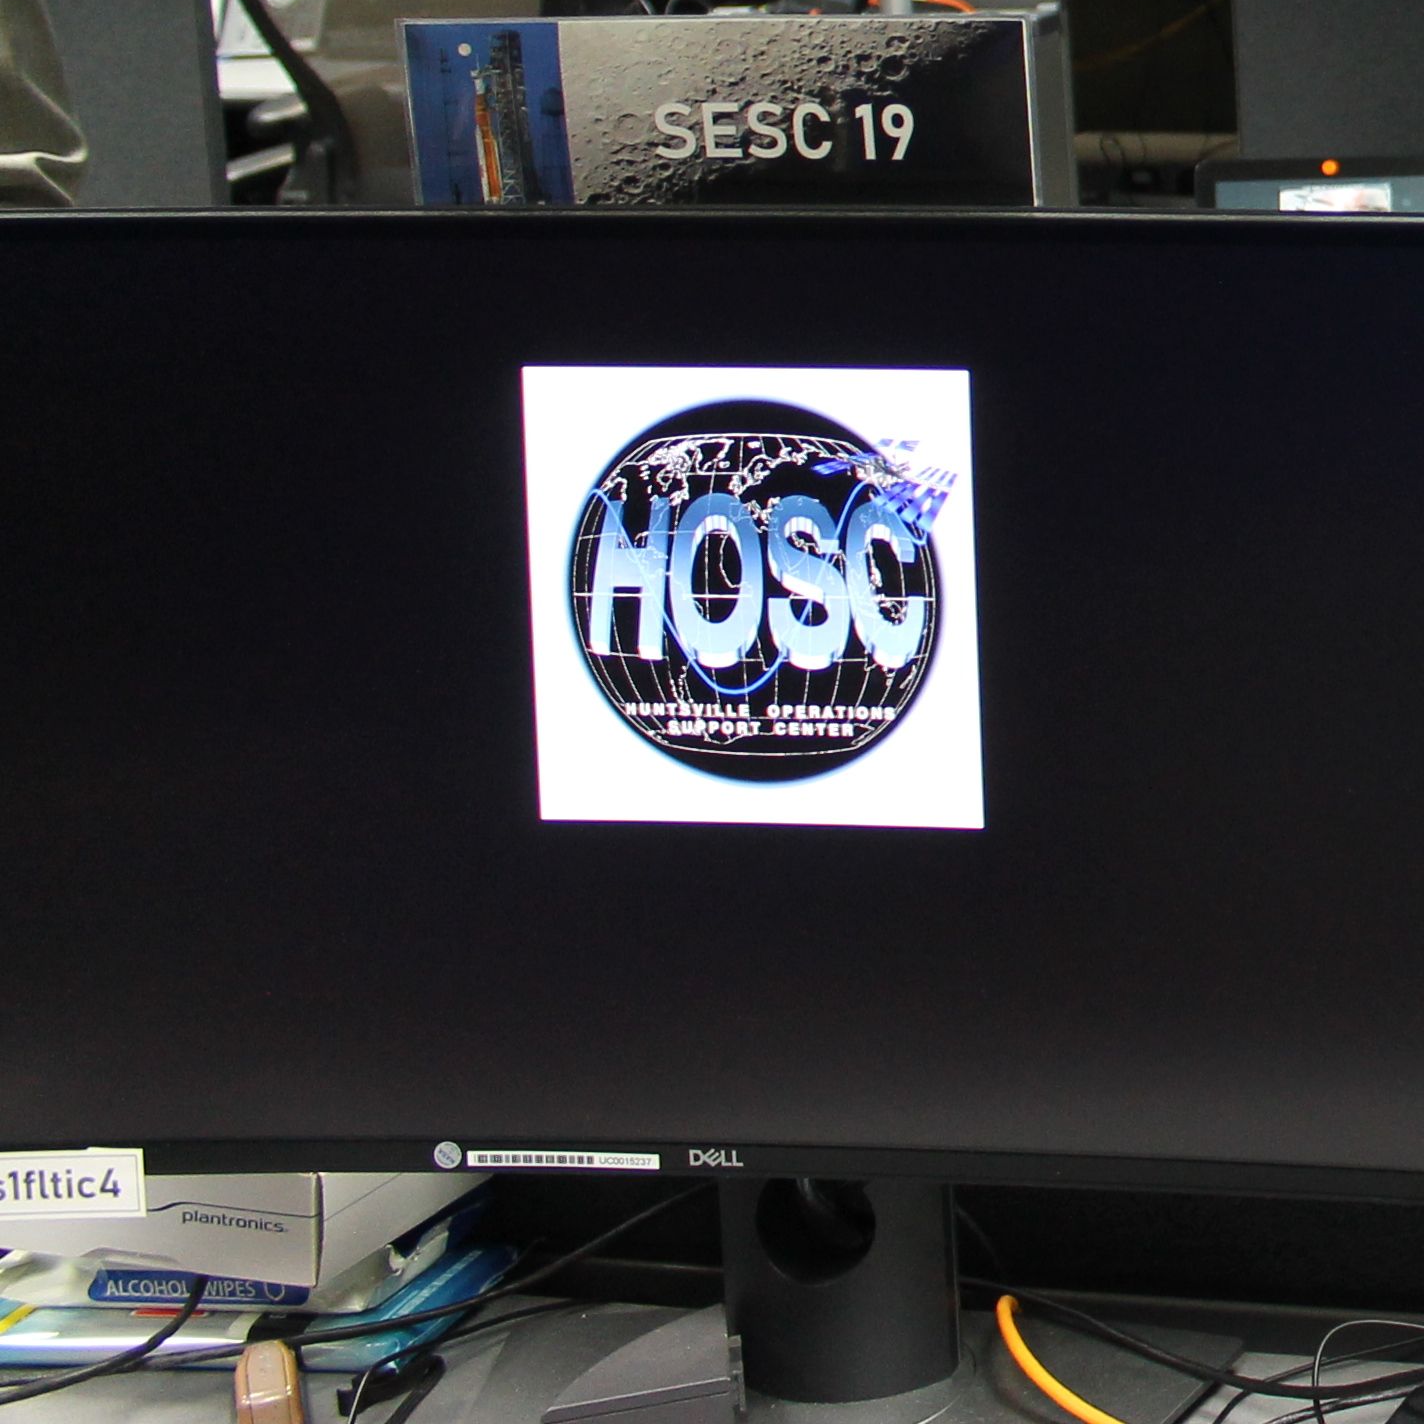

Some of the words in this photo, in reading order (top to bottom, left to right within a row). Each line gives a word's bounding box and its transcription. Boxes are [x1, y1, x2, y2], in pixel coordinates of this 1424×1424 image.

[654, 103, 833, 161] SESC
[855, 103, 915, 161] 19
[588, 492, 927, 672] HOSC
[625, 703, 750, 718] HUNTSVILLE
[766, 704, 897, 721] OPERATIONS
[667, 720, 761, 736] SUPPORT
[772, 721, 854, 737] CENTER
[599, 1156, 653, 1166] UC0015237
[689, 1148, 744, 1168] DELL
[182, 1209, 285, 1234] plantronics
[105, 1279, 190, 1296] ALCOHOL
